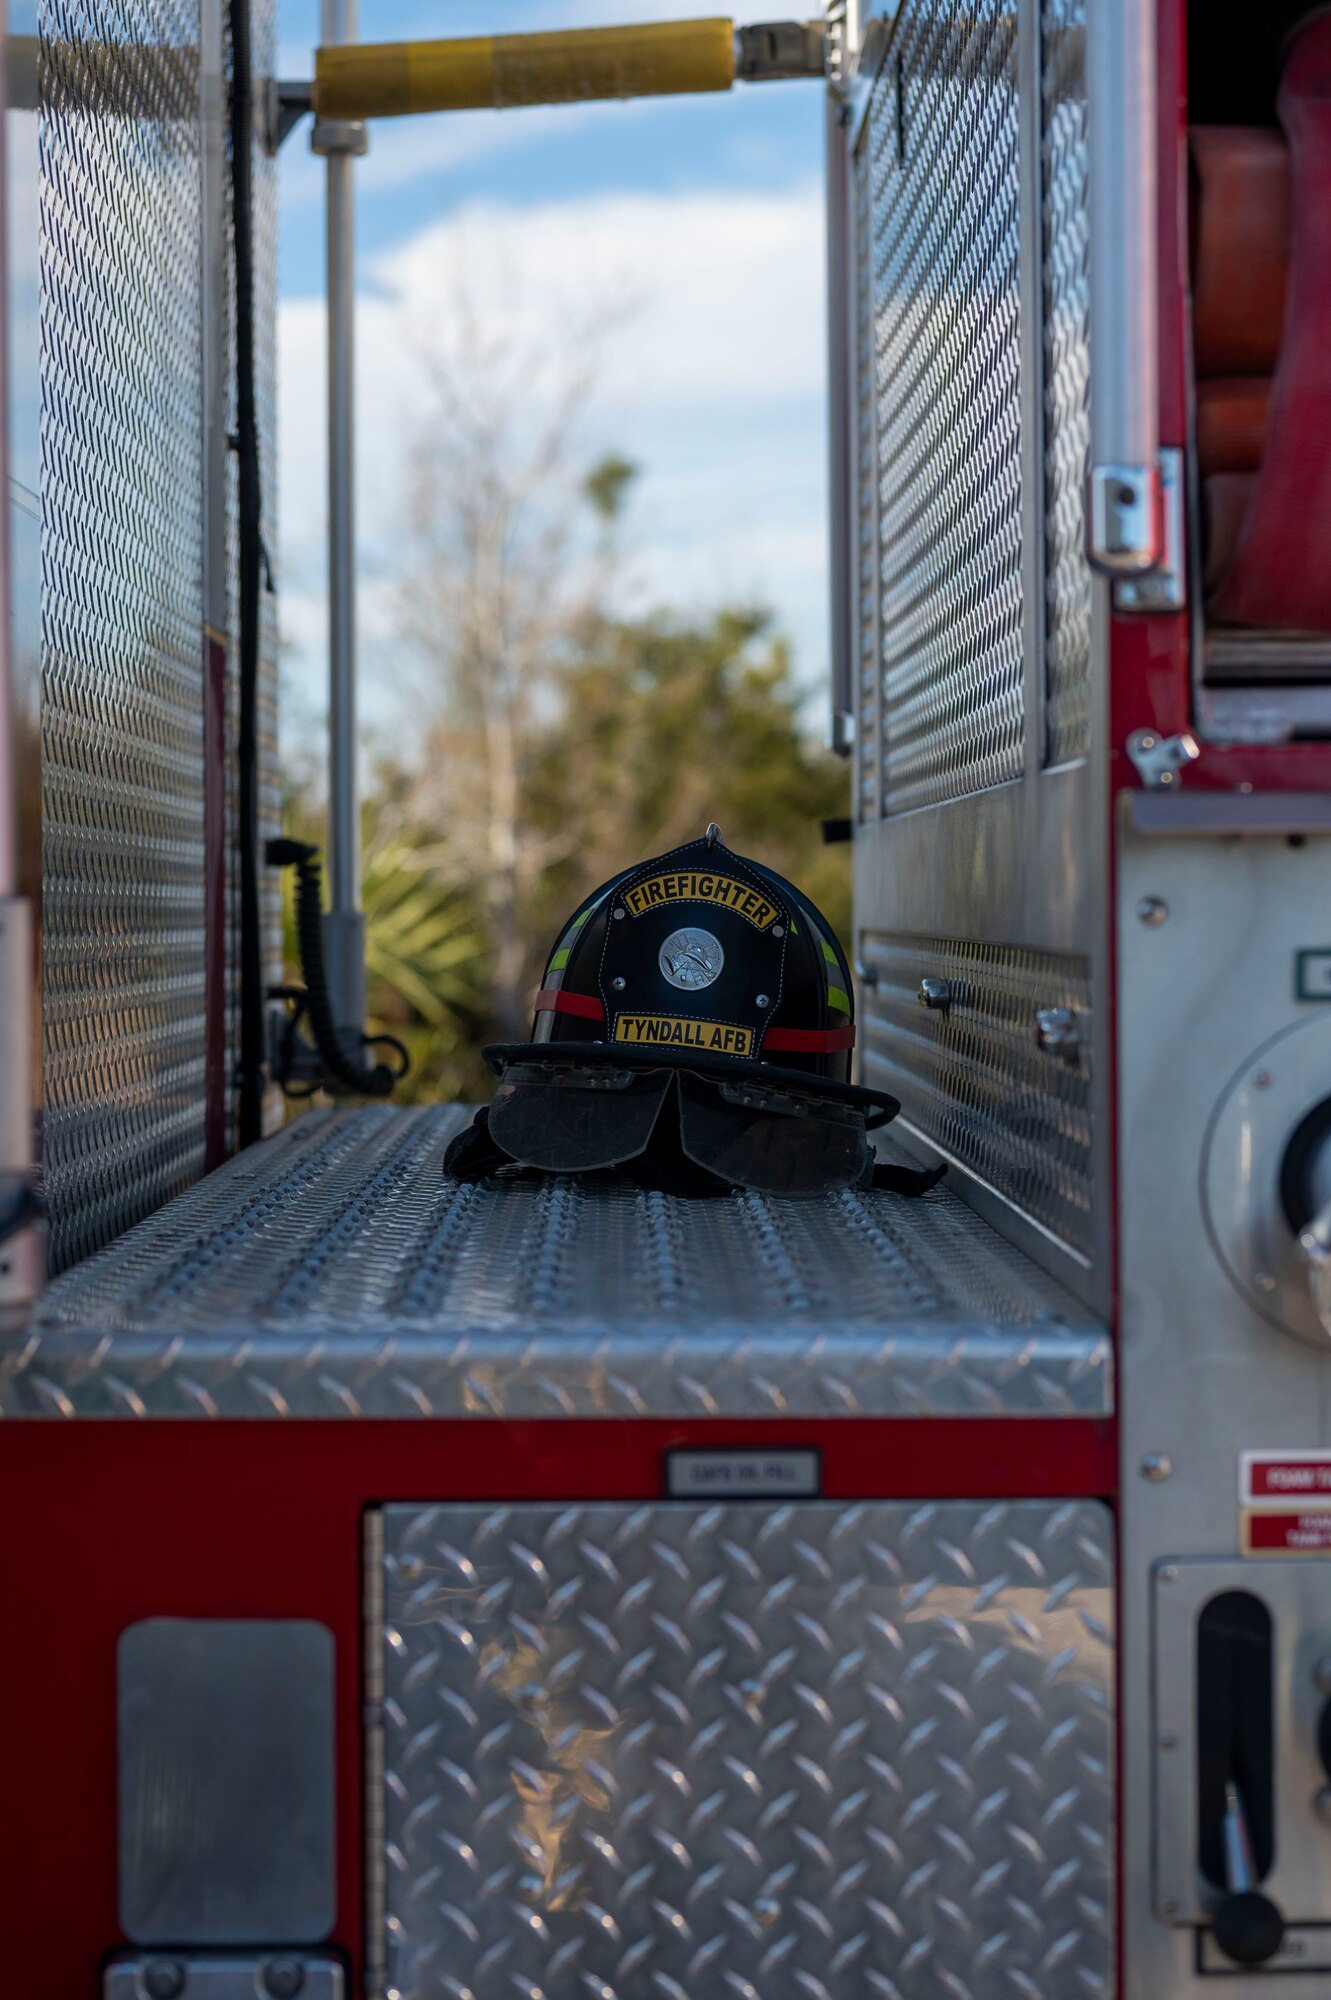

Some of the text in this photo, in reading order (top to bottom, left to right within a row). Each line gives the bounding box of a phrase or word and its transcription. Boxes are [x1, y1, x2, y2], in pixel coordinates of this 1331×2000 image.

[629, 875, 771, 925] FIREFIGHTER
[622, 1018, 747, 1052] TYNDALL AFB
